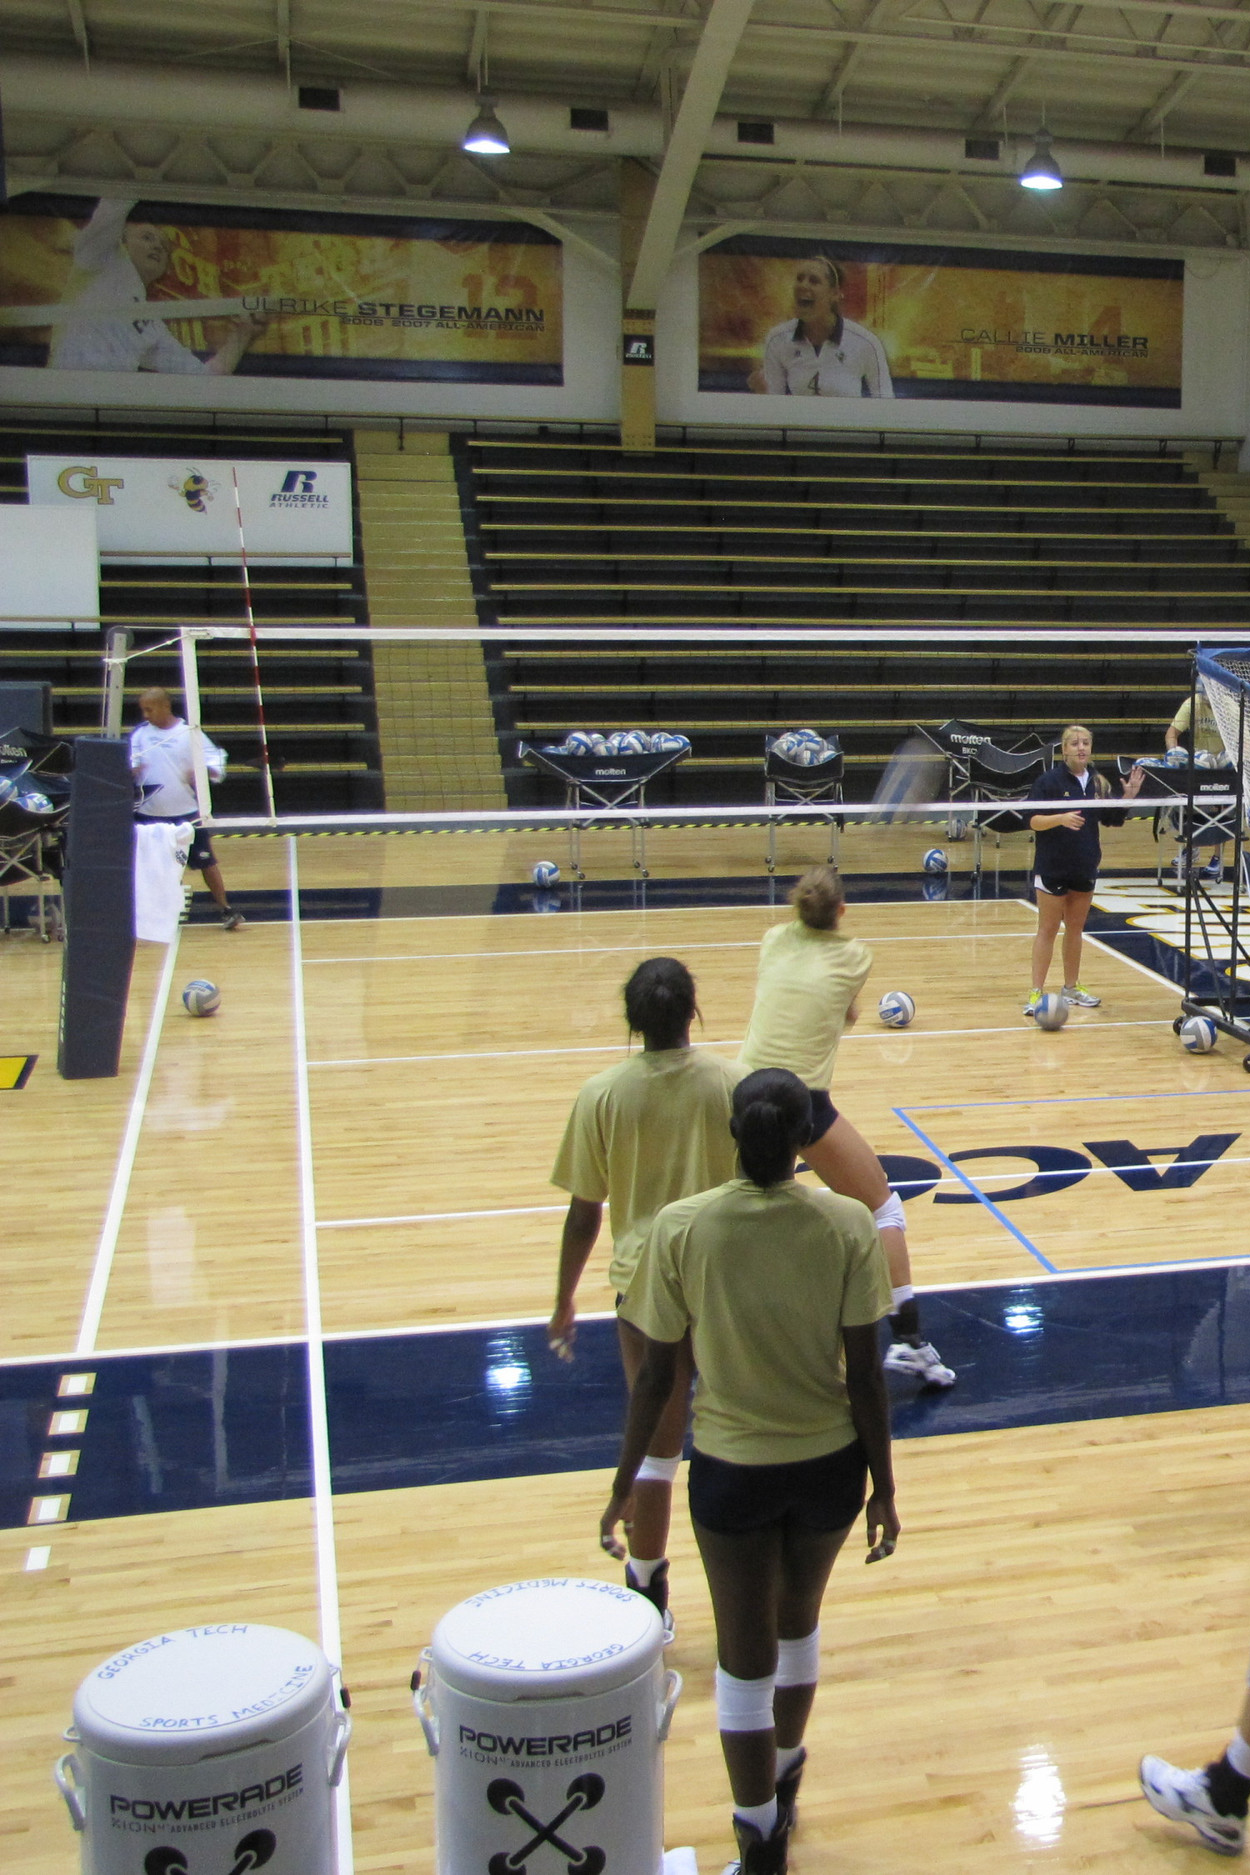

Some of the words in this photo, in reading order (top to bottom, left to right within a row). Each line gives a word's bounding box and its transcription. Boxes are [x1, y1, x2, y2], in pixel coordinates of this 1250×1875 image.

[242, 297, 349, 314] ULRIKE
[358, 302, 545, 322] STEGEMANN
[341, 317, 384, 327] 2006
[392, 319, 430, 328] 2007
[435, 321, 545, 332] ALL-AMERICAN
[961, 328, 1046, 344] CALLIE
[1054, 333, 1149, 349] MILLER
[1015, 346, 1051, 354] 2008
[1054, 347, 1149, 358] ALL-AMERICAN
[57, 466, 124, 505] GT
[270, 493, 329, 503] RUSSELL
[594, 768, 627, 776] molten
[464, 1578, 569, 1607] MEDICINE
[576, 1579, 639, 1603] SPORTS
[97, 1636, 176, 1680] GEORGIA
[186, 1624, 249, 1638] TECH
[468, 1651, 526, 1669] TECH
[541, 1643, 625, 1670] GEORGIA
[139, 1714, 219, 1728] SPORTS
[231, 1664, 313, 1719] MEDICINE
[459, 1714, 632, 1756] POWERADE
[510, 1758, 551, 1768] ADVANCED
[554, 1749, 605, 1767] ELECTROLYTE
[608, 1737, 633, 1754] SYSTEM
[110, 1762, 303, 1820] POWERADE
[170, 1820, 216, 1833] ADVANCED
[219, 1804, 276, 1827] ELECTROLYTE
[278, 1787, 304, 1807] SYSTEM
